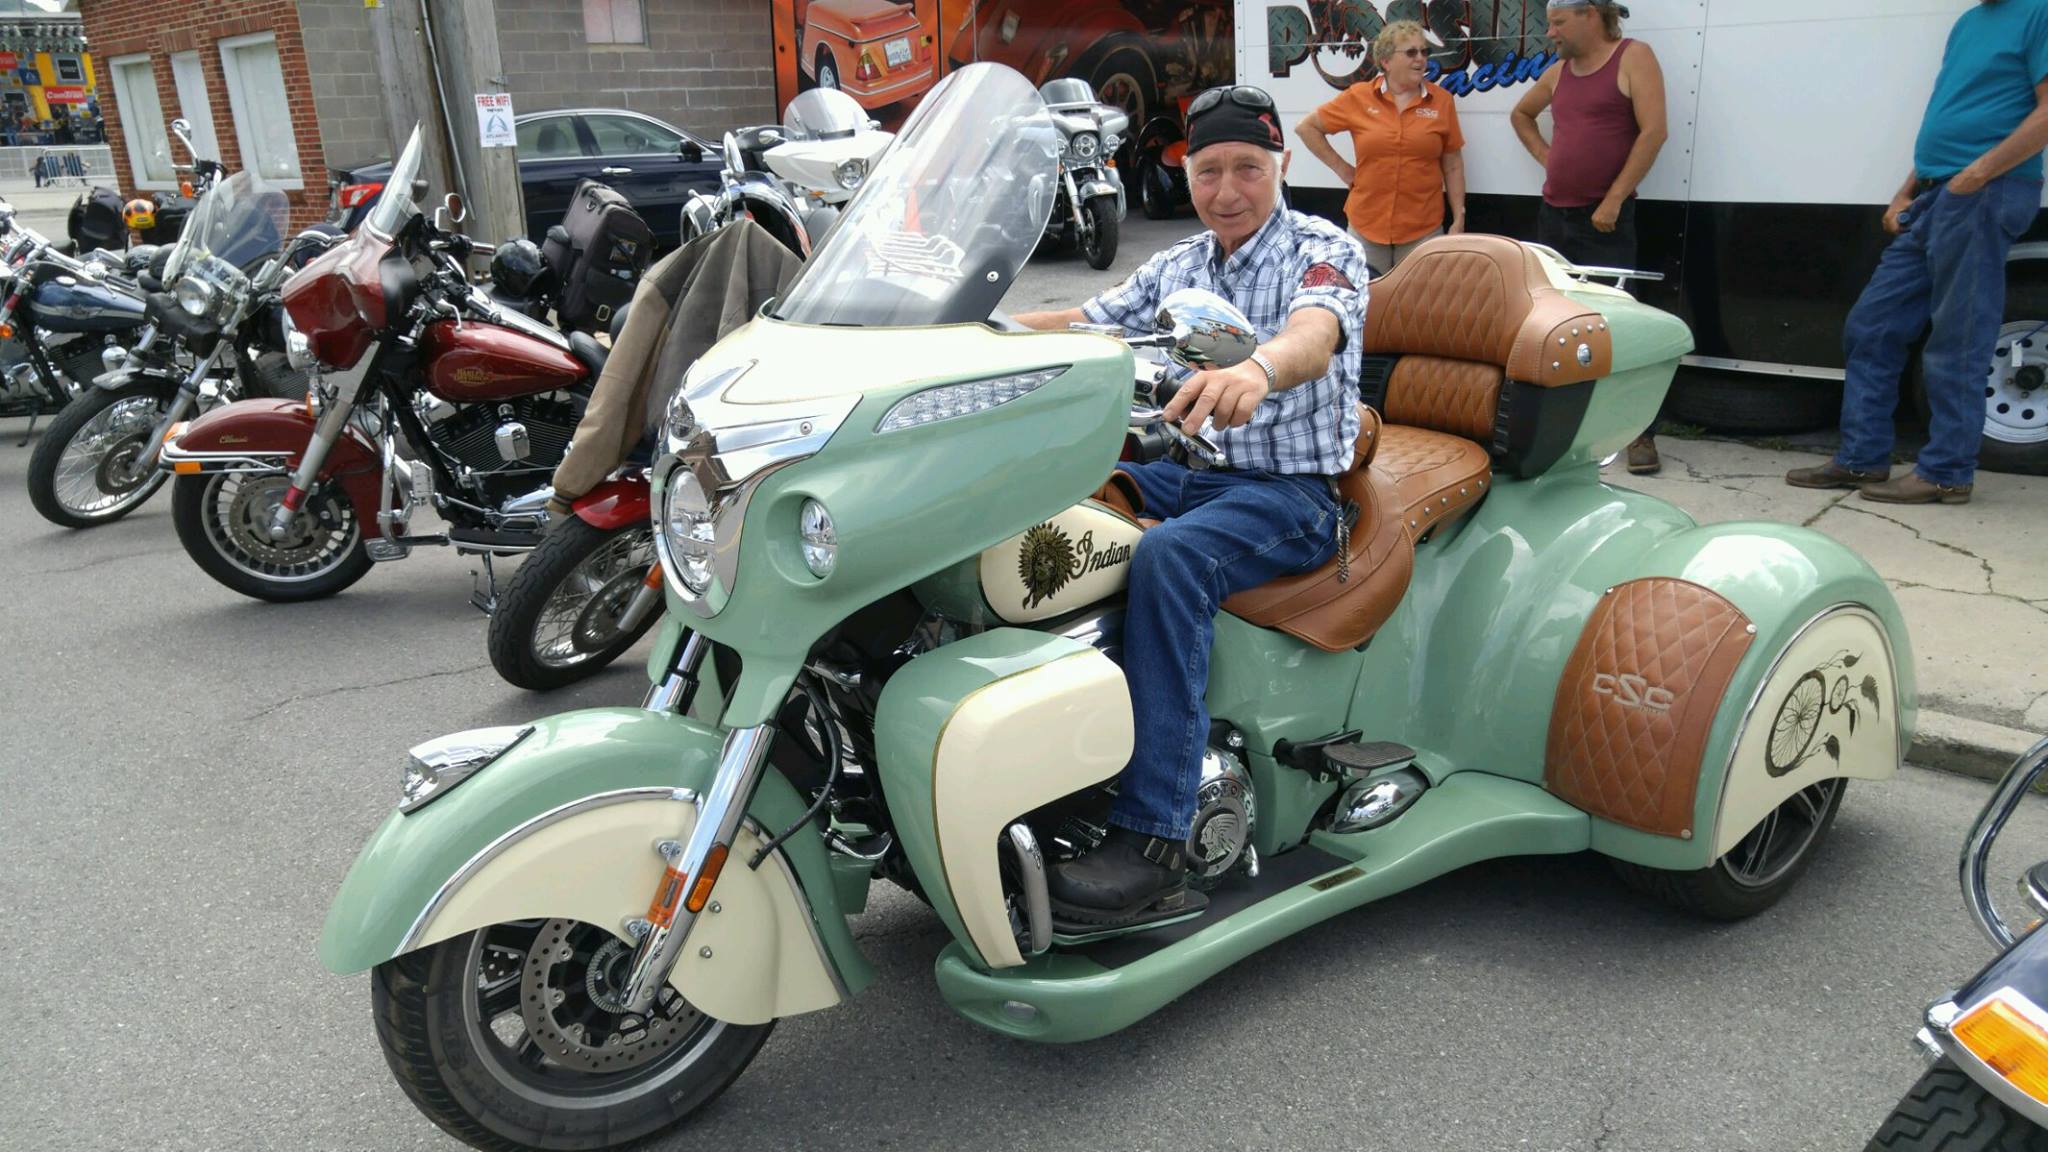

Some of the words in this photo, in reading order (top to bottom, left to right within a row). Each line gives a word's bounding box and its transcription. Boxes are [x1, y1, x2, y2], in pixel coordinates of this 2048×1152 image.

[1423, 50, 1560, 98] acin
[476, 95, 495, 107] FREE
[1069, 529, 1132, 580] Indian
